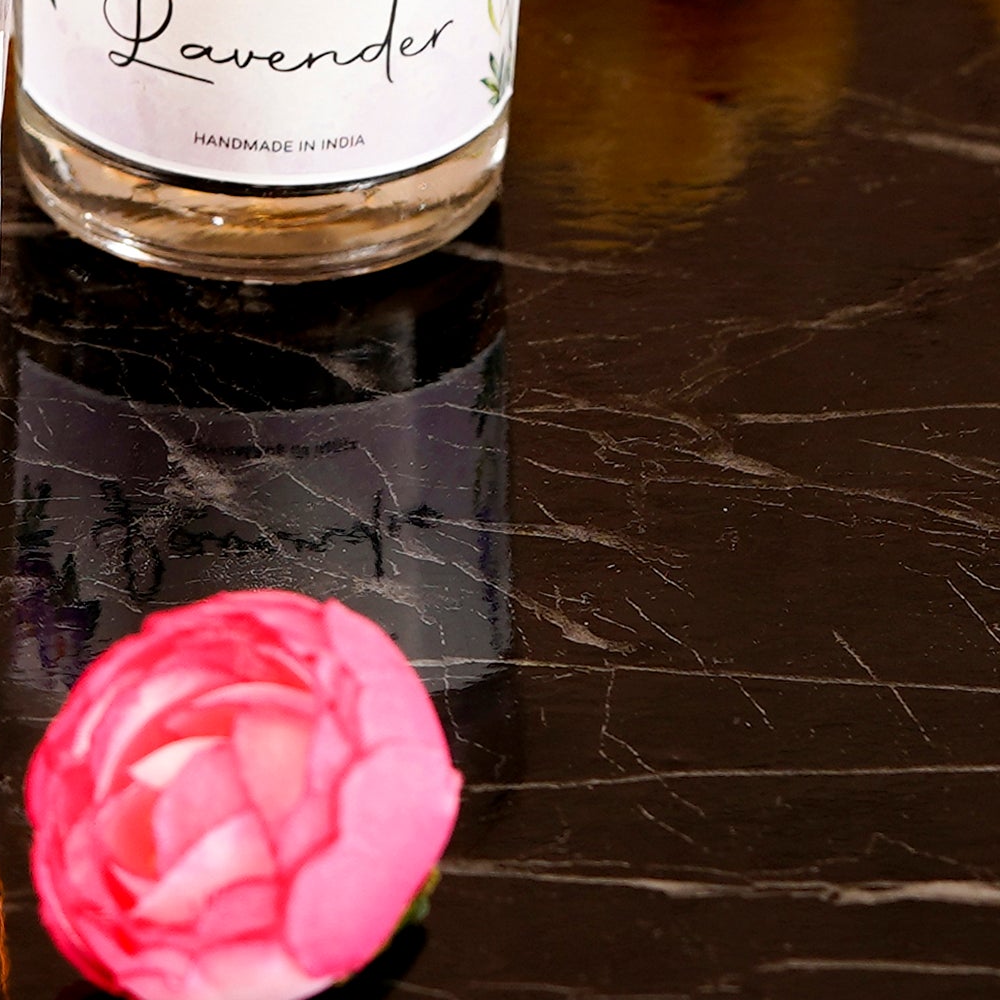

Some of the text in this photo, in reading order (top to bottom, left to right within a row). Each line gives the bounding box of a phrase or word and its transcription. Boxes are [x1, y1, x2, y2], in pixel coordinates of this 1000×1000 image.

[193, 131, 365, 153] HANDMADE IN INDIA
